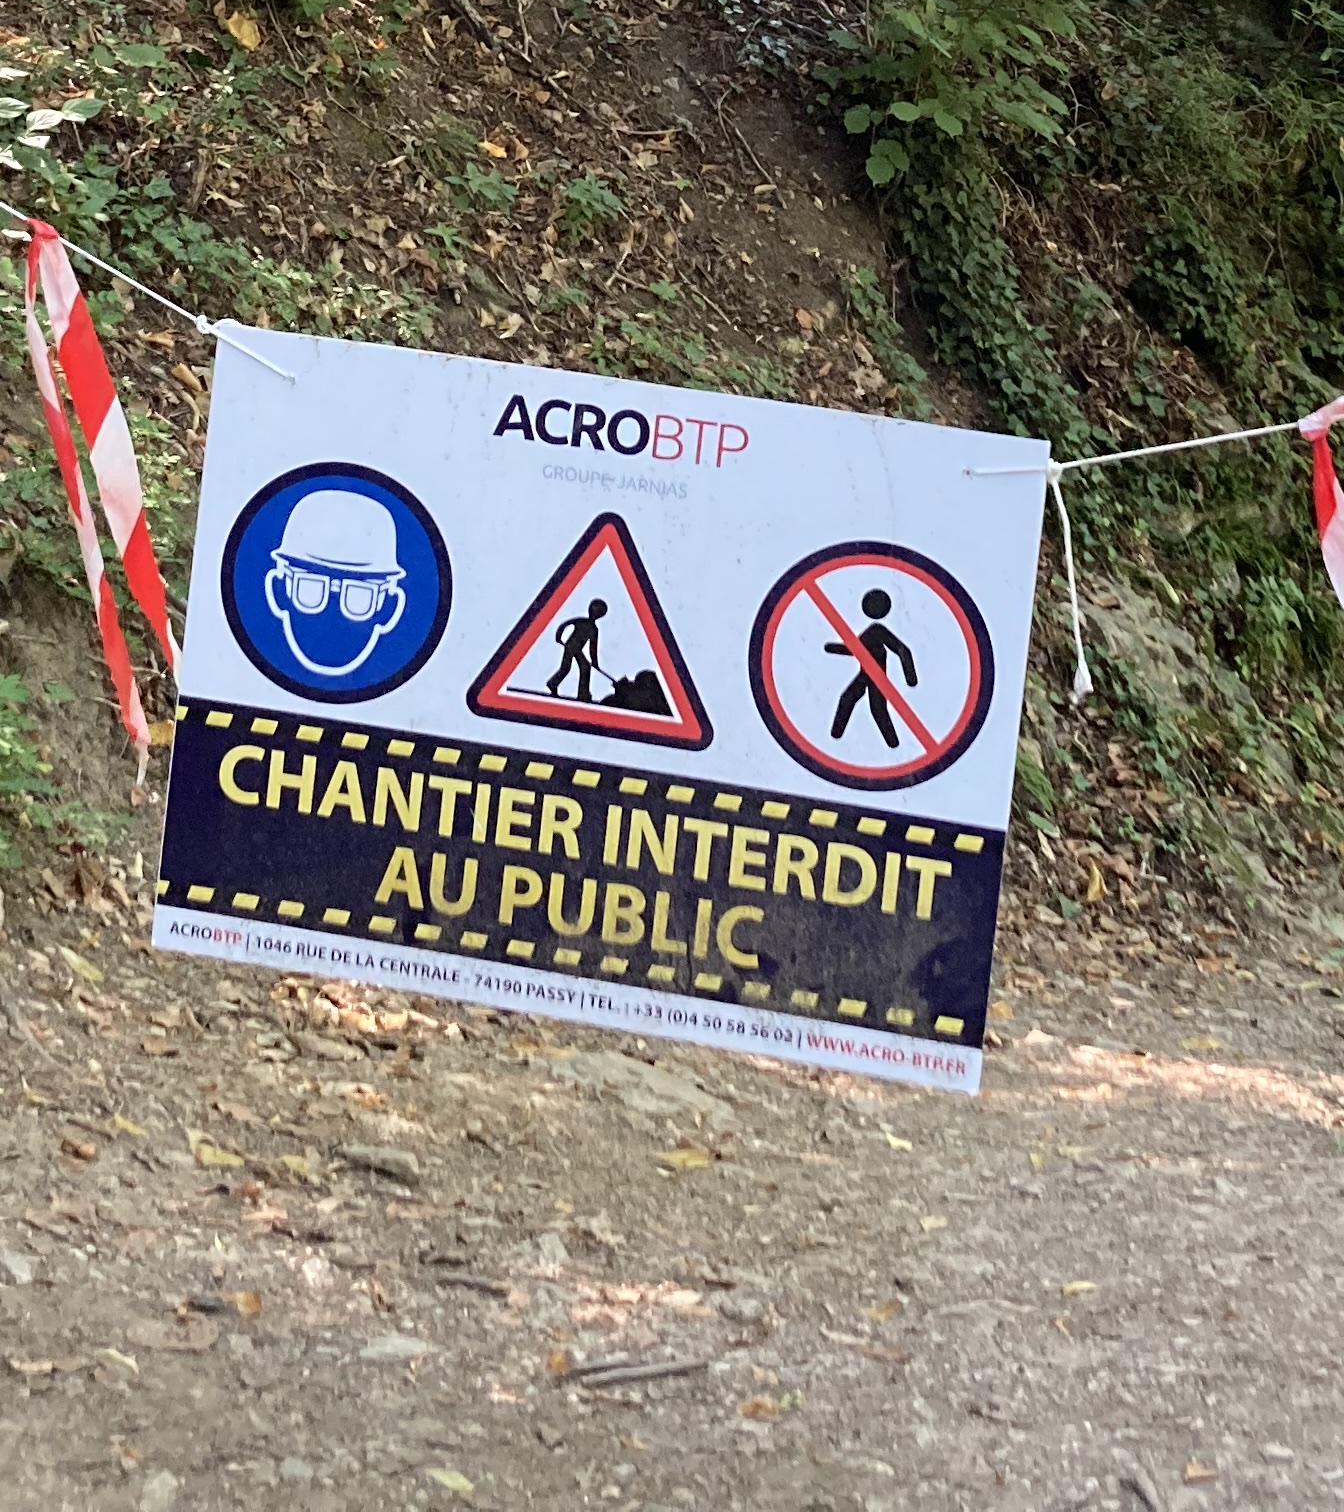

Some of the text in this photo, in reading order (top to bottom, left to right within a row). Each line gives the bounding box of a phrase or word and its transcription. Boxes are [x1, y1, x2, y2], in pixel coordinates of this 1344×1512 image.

[493, 394, 750, 468] ACROBTP
[542, 464, 612, 487] GROUPE
[217, 743, 952, 920] CHANTIER INTERDIT
[374, 845, 766, 970] AU PUBLIC
[170, 920, 242, 945] ACROBTP
[256, 936, 292, 955] 1046
[296, 942, 327, 961] RUE
[331, 948, 352, 964] DE
[355, 953, 376, 970] LA
[379, 957, 461, 984] CENTRALE
[474, 974, 523, 994] 74190
[526, 984, 577, 1005] PASSY
[633, 1002, 664, 1020] +33
[702, 1014, 722, 1030] 50
[726, 1019, 746, 1034] 58
